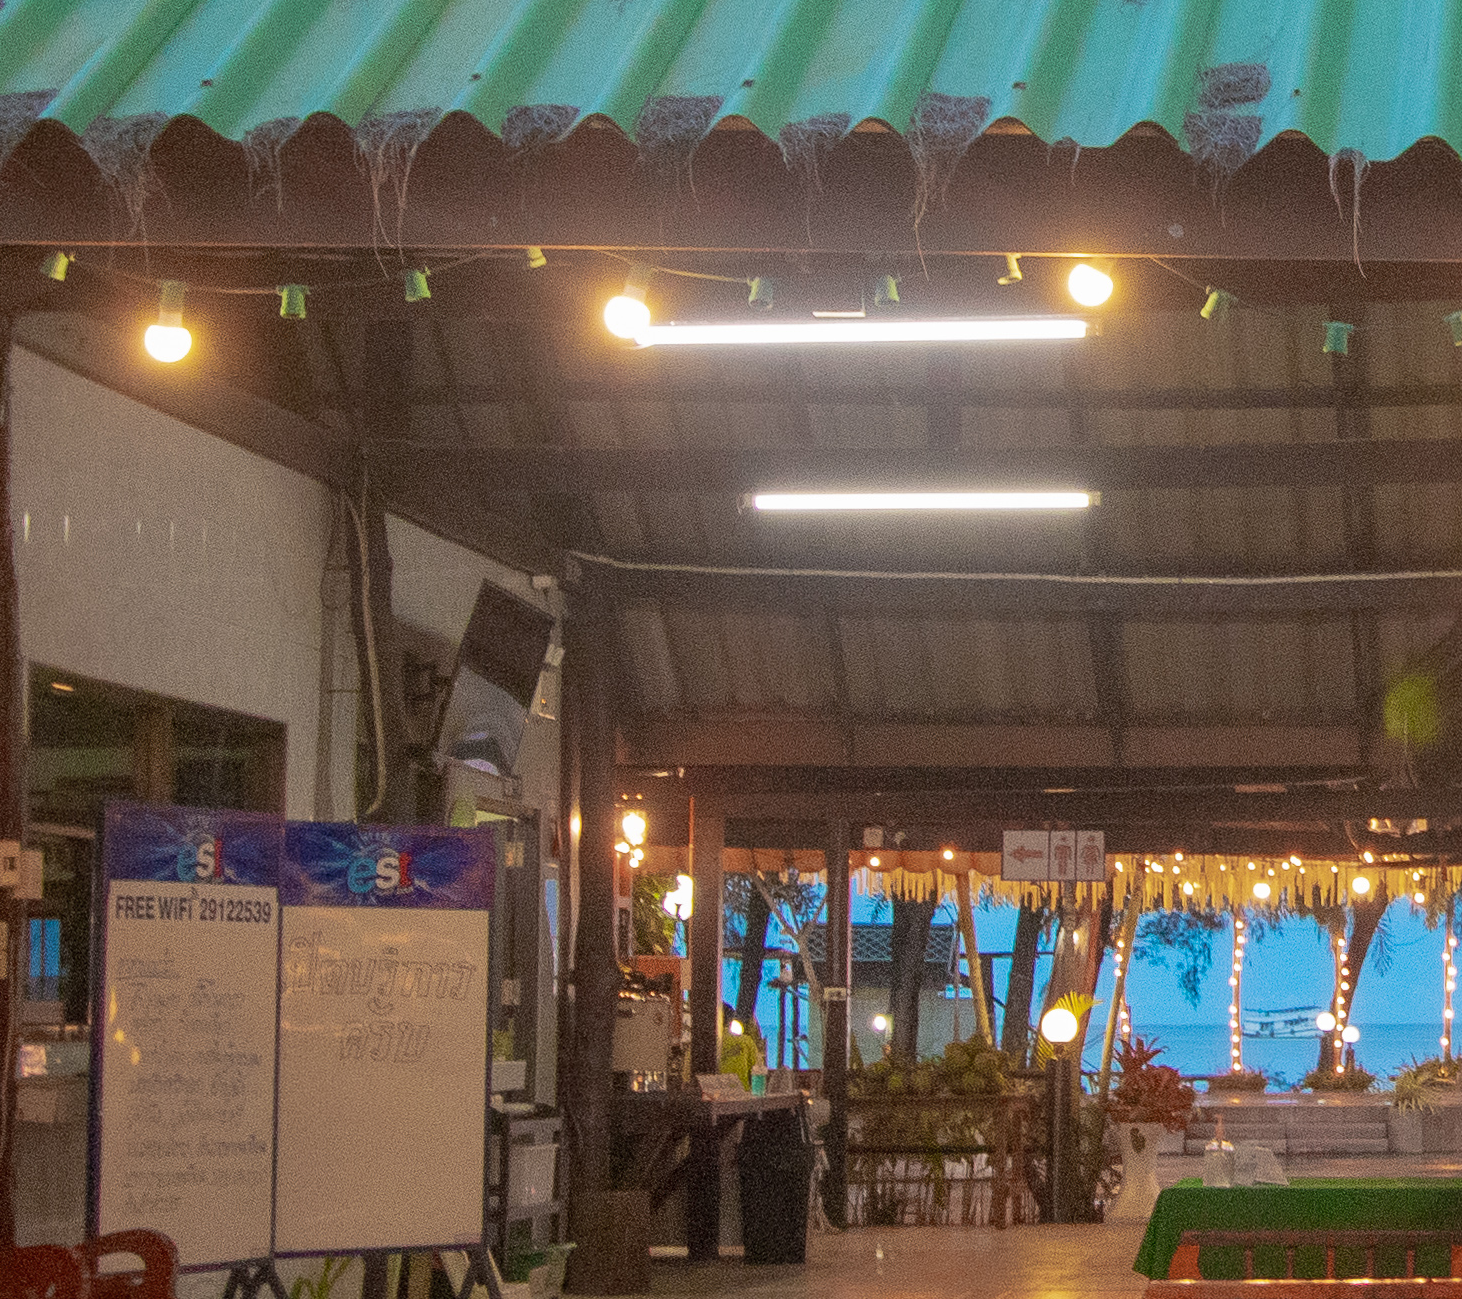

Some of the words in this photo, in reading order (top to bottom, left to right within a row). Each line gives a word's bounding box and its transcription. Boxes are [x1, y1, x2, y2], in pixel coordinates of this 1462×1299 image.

[347, 851, 412, 894] est
[115, 894, 155, 920] FREE
[198, 897, 272, 924] 29122539
